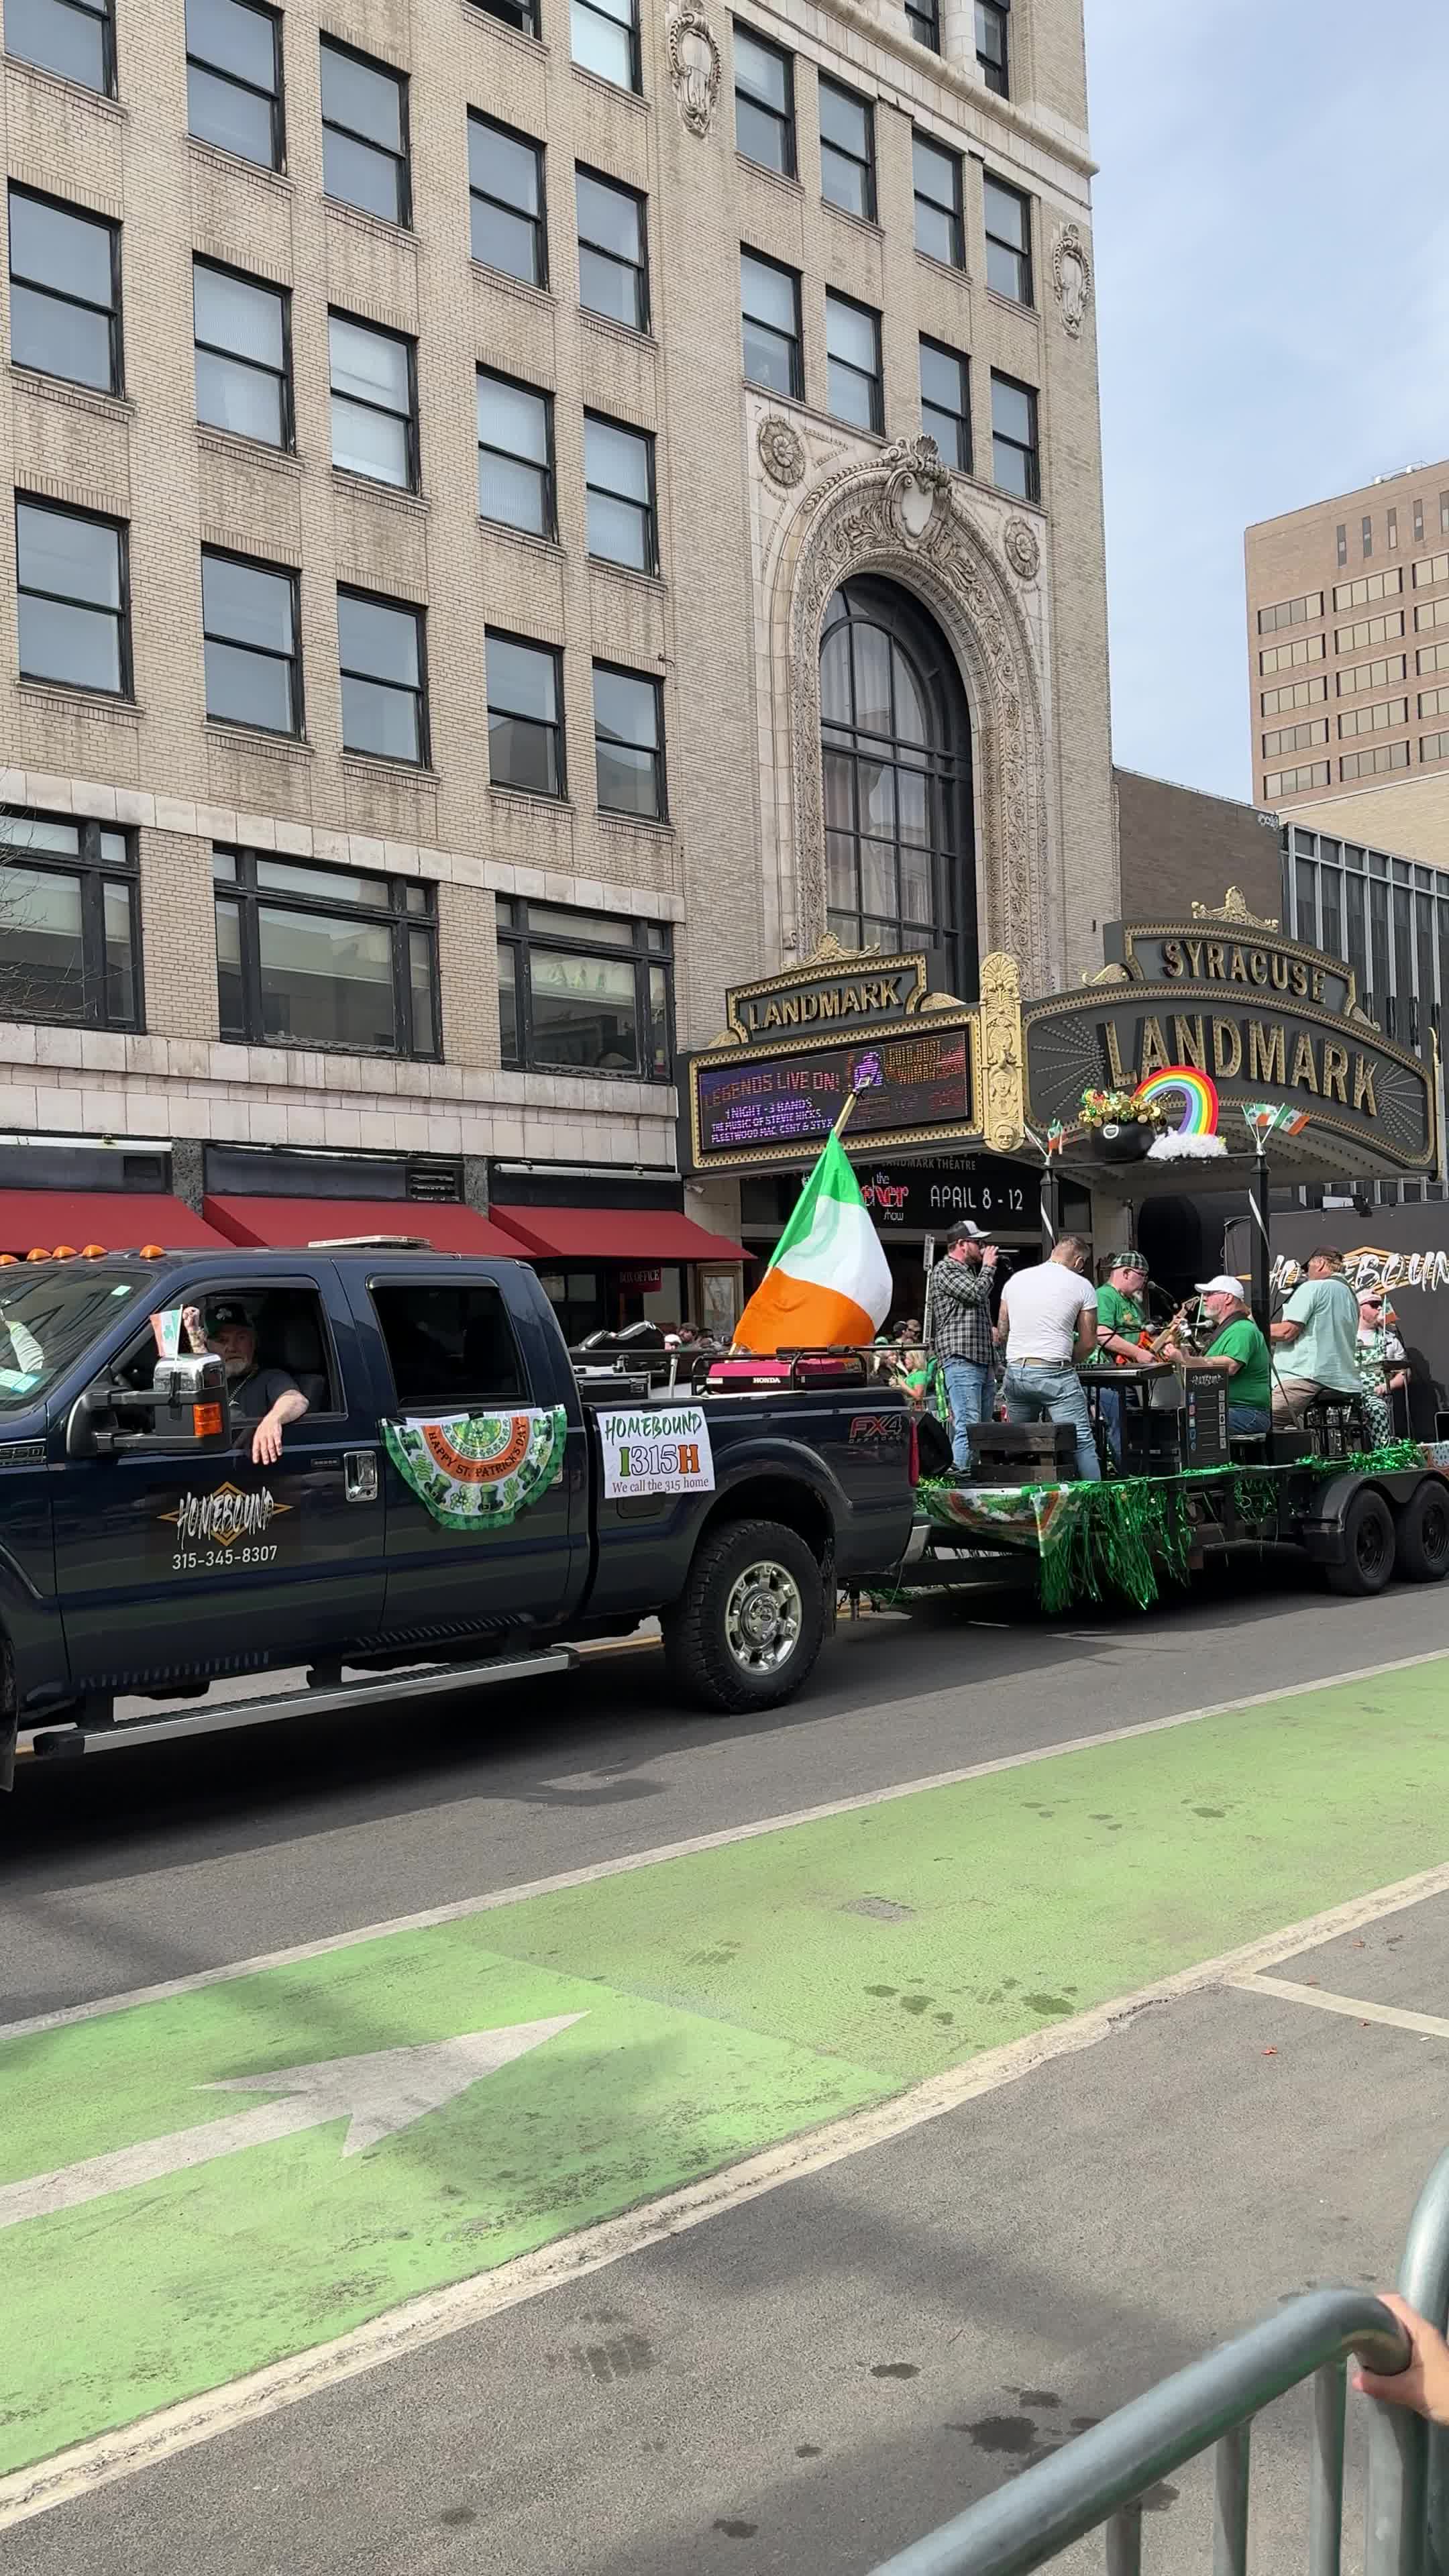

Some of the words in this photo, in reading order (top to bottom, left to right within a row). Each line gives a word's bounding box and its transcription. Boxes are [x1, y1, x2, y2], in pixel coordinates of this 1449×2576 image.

[1163, 939, 1326, 1004] SYRACUSE
[748, 977, 902, 1030] LANDMARK
[1100, 1014, 1379, 1118] LANDMARK
[777, 1071, 809, 1090] LIVE
[731, 1104, 762, 1118] NIGHT
[936, 1158, 977, 1171] THEATRE
[875, 1171, 890, 1185] the
[930, 1185, 977, 1210] APRIL
[982, 1187, 992, 1210] 8
[1008, 1188, 1024, 1212] 12
[605, 1410, 702, 1446] HOMEBOUND
[849, 1413, 902, 1439] FX4
[427, 1432, 458, 1467] HAPPY
[475, 1446, 521, 1477] PATRICK'S
[515, 1417, 527, 1447] DAY
[612, 1481, 628, 1493] We
[630, 1479, 646, 1492] call
[647, 1479, 663, 1491] the
[664, 1480, 681, 1493] 315
[683, 1477, 709, 1489] home
[172, 1545, 278, 1570] 315-345-8307
